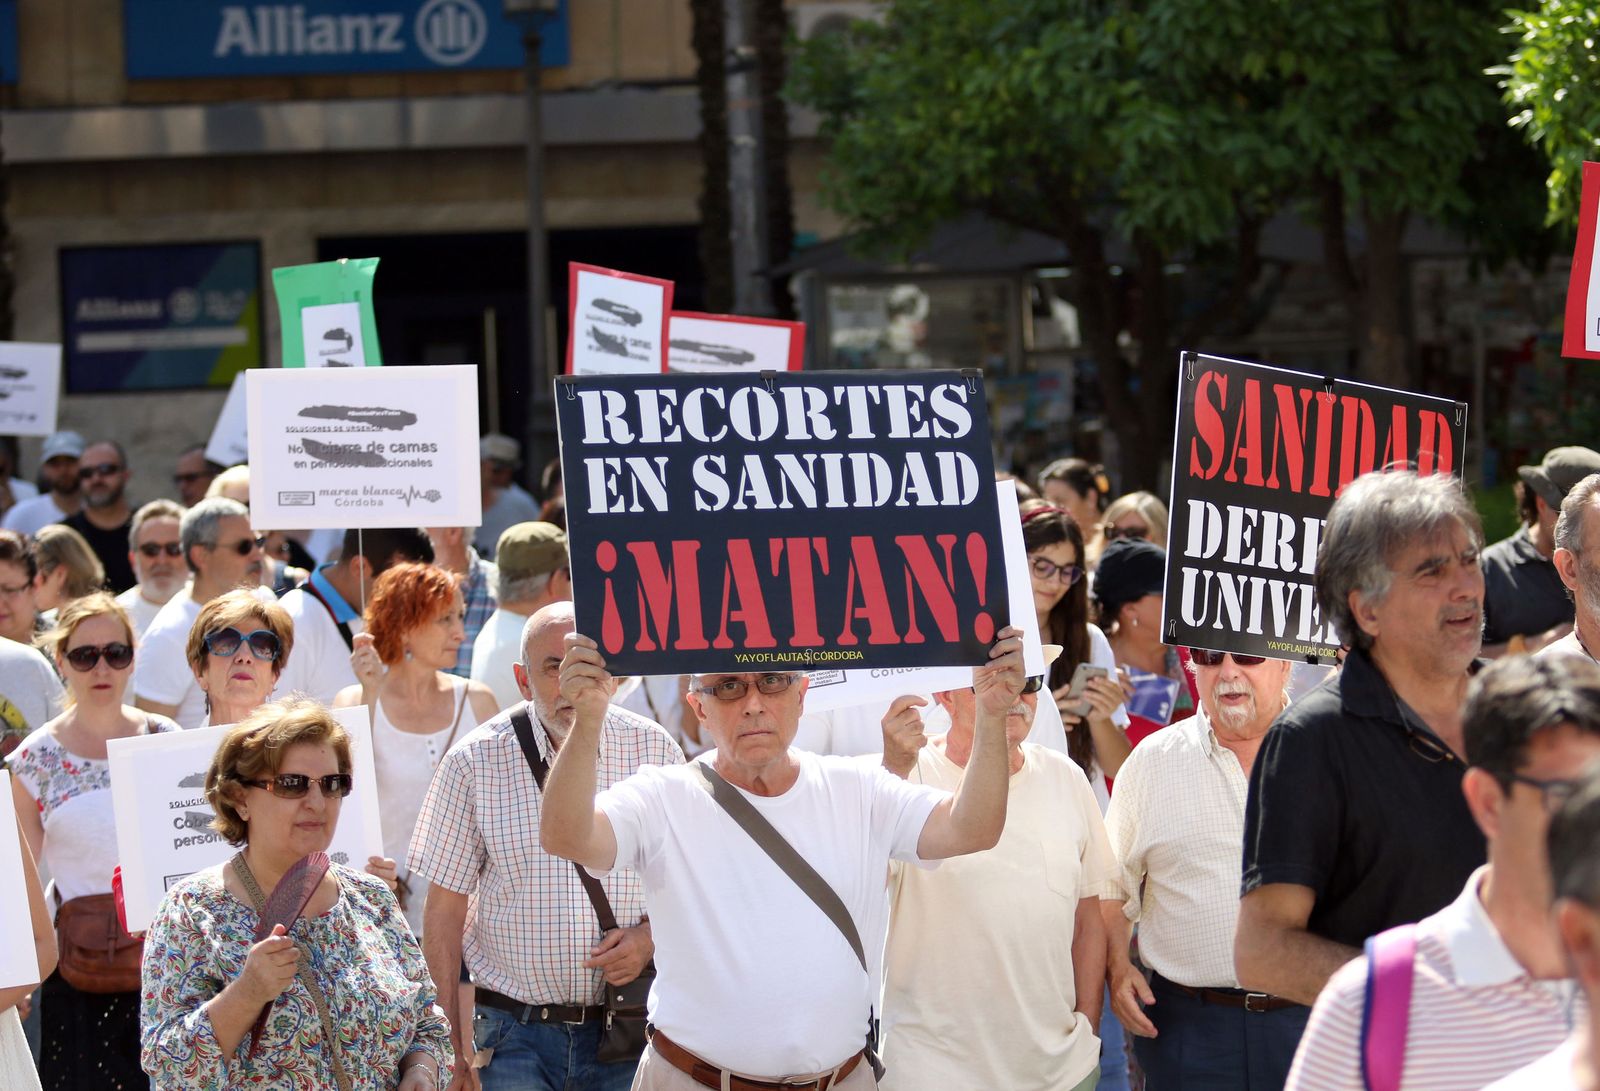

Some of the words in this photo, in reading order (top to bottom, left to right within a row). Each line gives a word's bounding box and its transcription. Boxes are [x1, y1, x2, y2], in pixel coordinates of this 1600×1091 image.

[213, 6, 405, 57] Allianz
[577, 384, 972, 445] RECORTES
[1190, 371, 1453, 499] SANIDAD
[287, 444, 303, 454] No
[367, 440, 385, 454] de
[389, 442, 438, 454] camas
[294, 460, 307, 469] en
[319, 487, 359, 496] marea
[362, 485, 404, 496] blanca
[583, 456, 669, 514] EN
[692, 452, 980, 512] SANIDAD
[595, 532, 995, 655] ¡MATAN!
[1267, 640, 1317, 656] YAYOFLAUTAS
[735, 652, 810, 663] YAYOFLAUTAS
[169, 796, 208, 809] SOLUCIO
[173, 833, 223, 850] person
